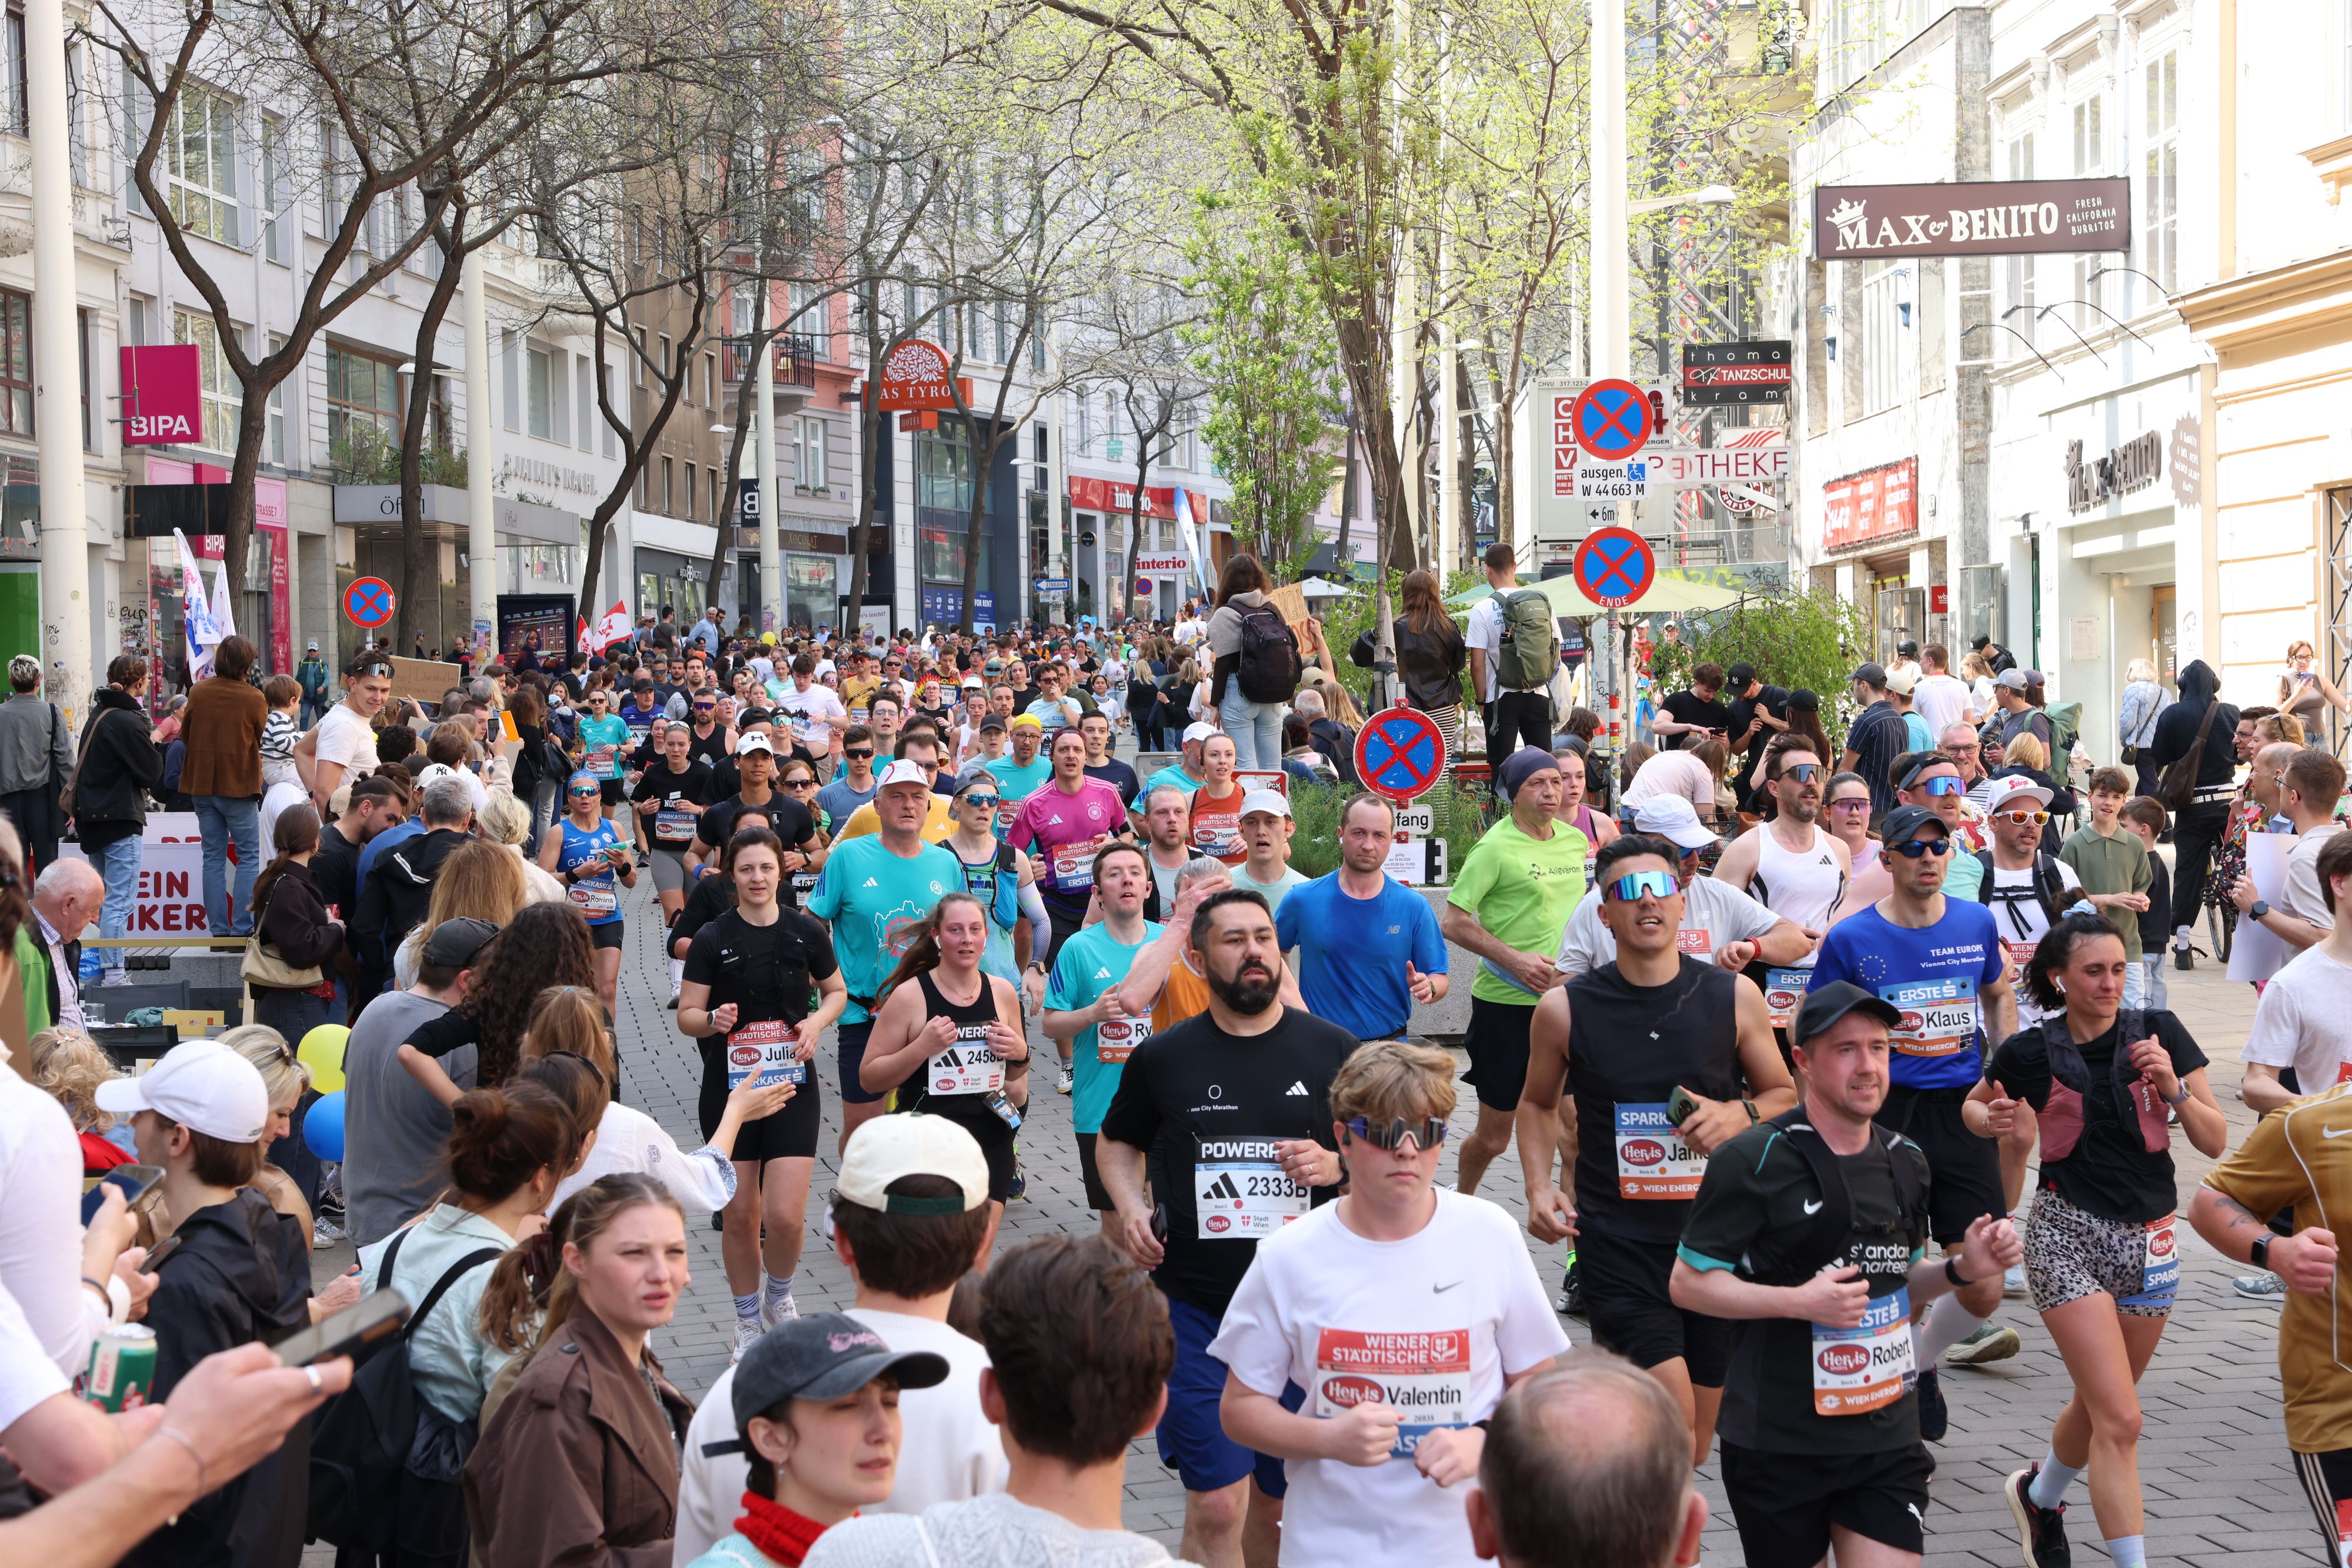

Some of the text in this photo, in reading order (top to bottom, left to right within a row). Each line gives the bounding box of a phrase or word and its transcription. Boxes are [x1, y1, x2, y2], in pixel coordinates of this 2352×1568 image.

[2076, 196, 2102, 209] FRESH
[2066, 207, 2116, 223] CALIFORNIA
[1836, 215, 1930, 251] MAX
[1949, 202, 2059, 242] BENITO
[2072, 219, 2115, 236] BURRITOS
[1691, 351, 1780, 362] thoma
[880, 385, 961, 400] AS TYRO
[1691, 390, 1778, 401] kram
[131, 415, 191, 437] BIPA
[901, 416, 920, 427] HOTEL
[1581, 469, 1626, 481] ausgen.
[1582, 484, 1591, 496] W
[1636, 484, 1645, 496] M
[1114, 486, 1151, 511] intio
[505, 509, 517, 529] Öfferl
[1602, 507, 1615, 521] 6m
[205, 534, 224, 553] BIPA
[789, 532, 818, 549] XOCOLAT
[1135, 556, 1187, 570] interio
[1599, 596, 1629, 607] ENDE
[2164, 636, 2176, 644] BENITO
[793, 727, 806, 736] Jakob
[436, 766, 447, 775] NY
[2009, 780, 2029, 790] Stiegl
[1058, 847, 1089, 856] STÄDTISCHE
[1067, 841, 1088, 850] WIENER
[1207, 847, 1228, 855] ERSTE
[1549, 866, 1582, 875] Aligvárom
[577, 879, 608, 888] PARKASSE
[1068, 877, 1090, 887] ERSTE
[572, 892, 614, 904] Hervis Romina
[1930, 944, 1983, 957] TEAM EUROPE
[1770, 995, 1794, 1006] Hervis
[1899, 987, 1942, 1002] ERSTE
[1896, 1011, 1971, 1028] ervis Klaus
[749, 1022, 780, 1031] WIENER
[1103, 1026, 1130, 1037] Hervis
[734, 1029, 781, 1040] STÄDTISCHE
[1903, 1042, 1957, 1052] WIEN ENERGIE
[733, 1046, 796, 1062] Hervis Julia
[1621, 1112, 1671, 1125] SPARK
[1625, 1145, 1662, 1161] Hervis
[1208, 1219, 1229, 1229] Hervis
[1364, 1333, 1429, 1349] WIENER
[1333, 1346, 1429, 1365] STÄDTISCHE
[1823, 1336, 1910, 1368] Hervis Robert
[1328, 1380, 1462, 1406] Hervis Valentin
[1845, 1383, 1900, 1406] WIEN ENERGIE
